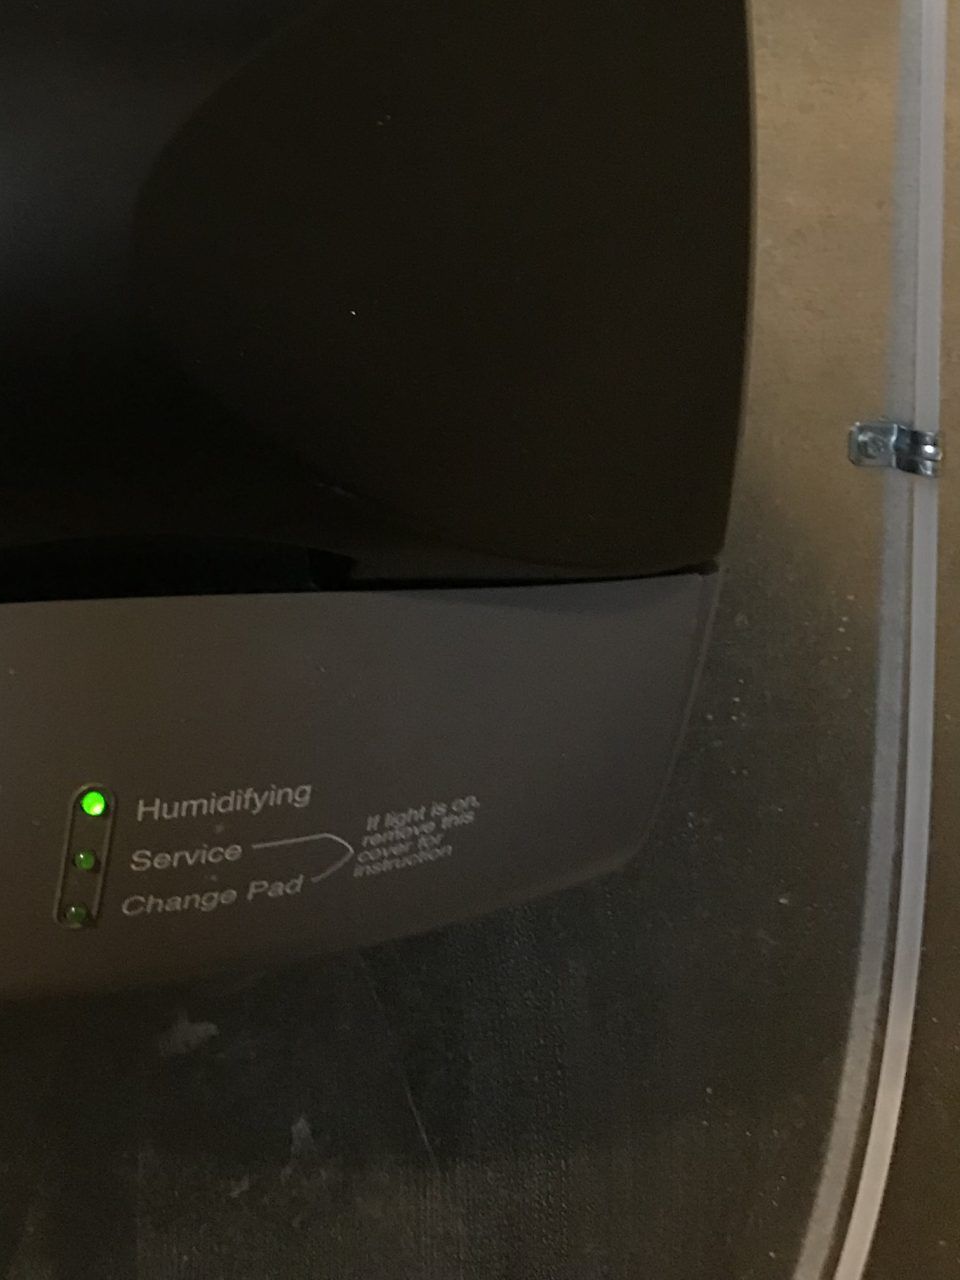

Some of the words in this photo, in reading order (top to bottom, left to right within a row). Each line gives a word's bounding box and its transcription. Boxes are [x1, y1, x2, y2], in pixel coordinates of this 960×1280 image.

[136, 783, 312, 822] Humidifying
[366, 814, 381, 832] If
[384, 804, 426, 830] light
[431, 800, 448, 818] is
[362, 821, 436, 847] remove
[441, 810, 475, 830] this
[130, 841, 243, 872] Service
[356, 841, 415, 863] cover
[417, 833, 445, 851] for
[121, 886, 238, 917] Change
[247, 874, 305, 902] Pad
